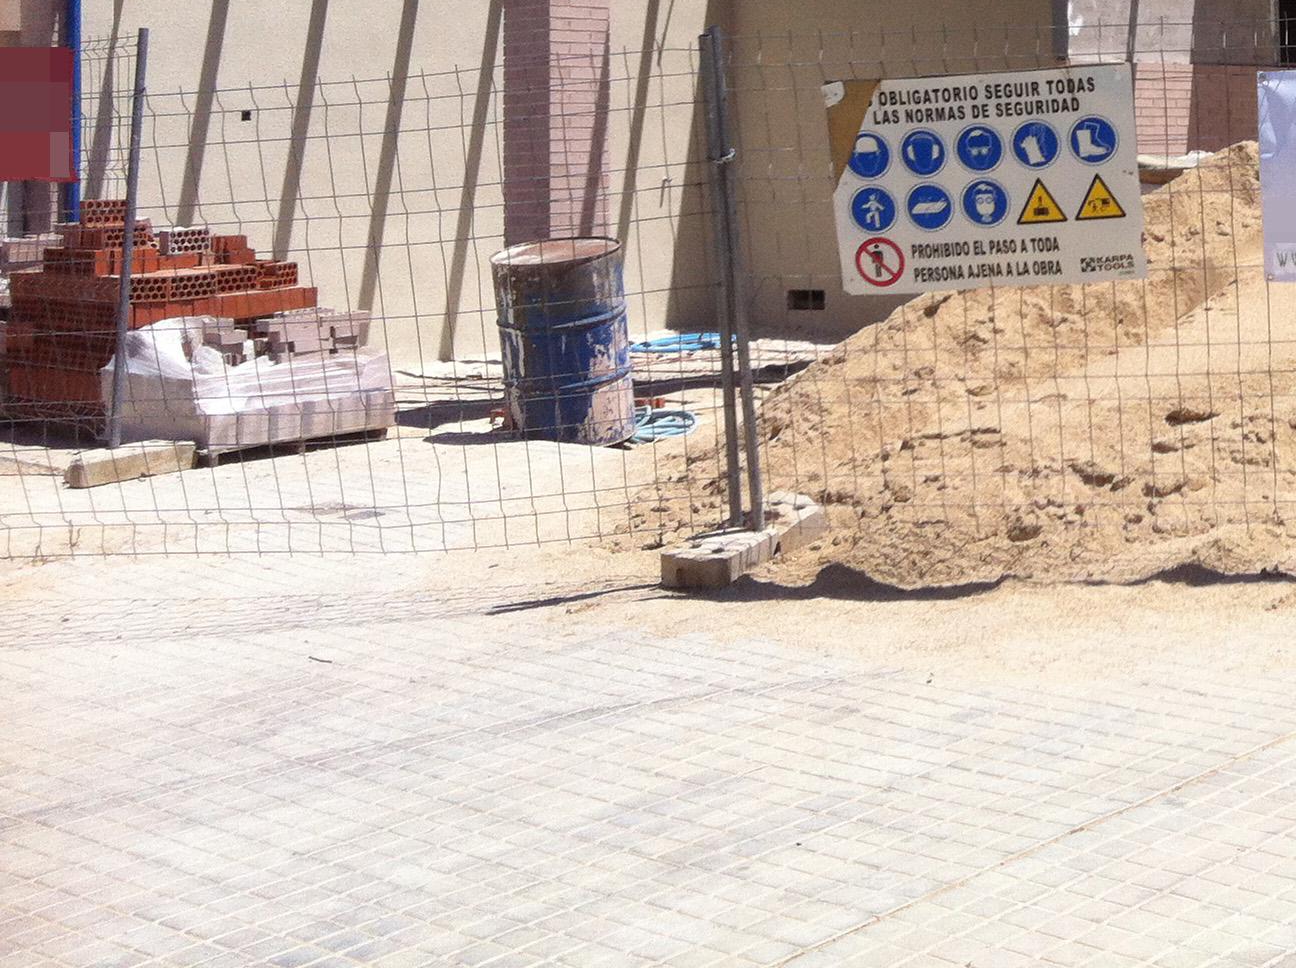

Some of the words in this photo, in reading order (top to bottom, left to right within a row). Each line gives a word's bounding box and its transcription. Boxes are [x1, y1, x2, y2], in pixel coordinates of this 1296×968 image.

[878, 86, 978, 107] OBLIGATORIO
[984, 81, 1039, 99] SEGUIR
[1046, 77, 1095, 95] TODAS
[873, 109, 900, 125] LAS
[905, 105, 965, 124] NORMAS
[972, 103, 990, 119] DE
[996, 97, 1080, 117] SEGURIDAD
[911, 241, 970, 259] PROHIBIDO
[973, 240, 986, 255] EL
[989, 239, 1016, 254] PASO
[1020, 238, 1028, 253] A
[1030, 237, 1060, 252] TODA
[914, 265, 964, 282] PERSONA
[968, 263, 1003, 278] AJENA
[1006, 262, 1014, 277] A
[1016, 261, 1030, 276] LA
[1032, 260, 1063, 275] OBRA
